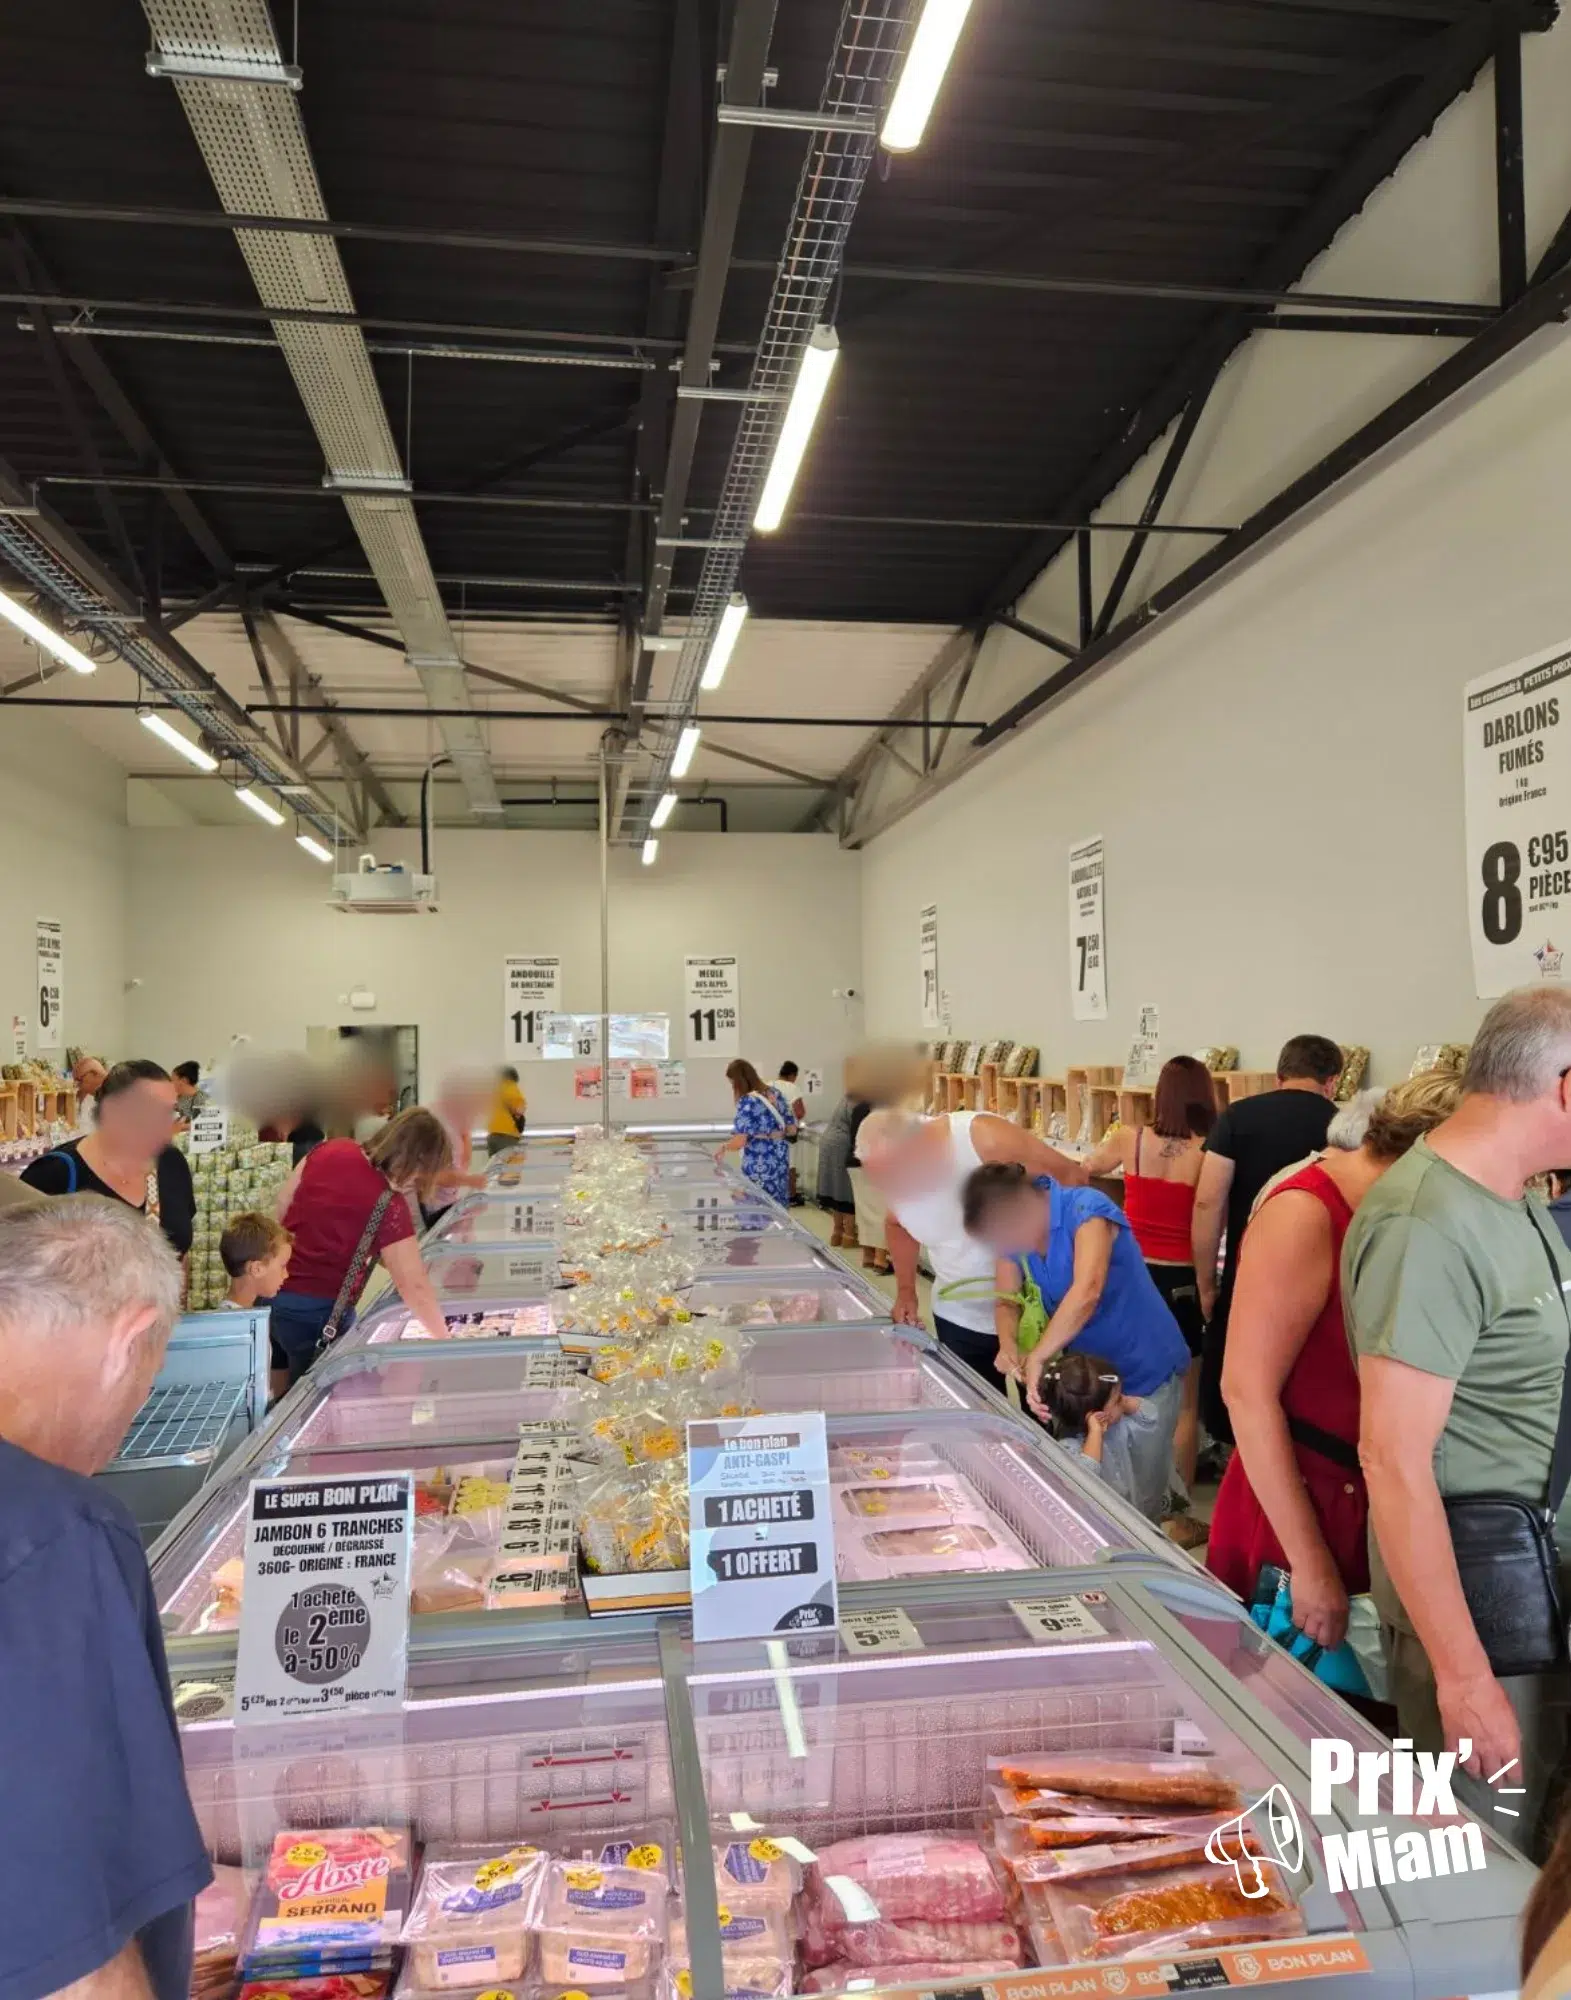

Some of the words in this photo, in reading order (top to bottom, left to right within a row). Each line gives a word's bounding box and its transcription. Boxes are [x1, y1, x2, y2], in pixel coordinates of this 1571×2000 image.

[1484, 698, 1559, 748] DARLONS
[1499, 739, 1544, 774] FUMÉS
[1524, 787, 1547, 801] France
[1482, 841, 1522, 945] 8
[1528, 830, 1569, 868] €95
[1529, 869, 1571, 899] PIÈCE
[1076, 935, 1087, 991] 7
[511, 970, 554, 979] ANDOUILLE
[699, 970, 724, 979] MEULE
[521, 980, 554, 989] BRETAGNE
[708, 981, 728, 989] ALPES
[40, 985, 49, 1027] 6
[511, 1010, 534, 1043] 11
[690, 1009, 716, 1042] 11
[578, 1040, 590, 1055] 13
[724, 1438, 738, 1451] Le
[739, 1436, 761, 1450] bon
[762, 1434, 788, 1450] plan
[724, 1451, 790, 1470] ANTI-GASPI
[265, 1493, 280, 1509] LE
[281, 1490, 319, 1507] SUPER
[323, 1486, 356, 1506] BON
[360, 1484, 398, 1503] PLAN
[718, 1499, 729, 1523] 1
[732, 1491, 802, 1521] ACHETÉ
[254, 1523, 312, 1543] JAMBON
[317, 1522, 327, 1539] 6
[332, 1517, 403, 1537] TRANCHES
[507, 1518, 541, 1530] 13
[504, 1541, 539, 1549] 6
[299, 1556, 343, 1573] ORIGINE
[355, 1553, 397, 1569] FRANCE
[721, 1553, 732, 1577] 1
[735, 1548, 802, 1577] OFFERT
[496, 1573, 532, 1583] 9
[292, 1592, 300, 1609] 1
[304, 1587, 356, 1608] acheté
[1040, 1617, 1064, 1632] 9
[284, 1628, 300, 1646] le
[854, 1629, 881, 1647] 5
[266, 1699, 278, 1707] les
[345, 1690, 371, 1703] pièce
[279, 1857, 392, 1901] Aoste
[286, 1902, 378, 1918] SERRANO
[1267, 1953, 1306, 1972] BON
[1308, 1948, 1355, 1968] PLAN
[1136, 1968, 1161, 1986] BO
[1006, 1983, 1047, 2000] BON
[1050, 1977, 1097, 1997] PLAN
